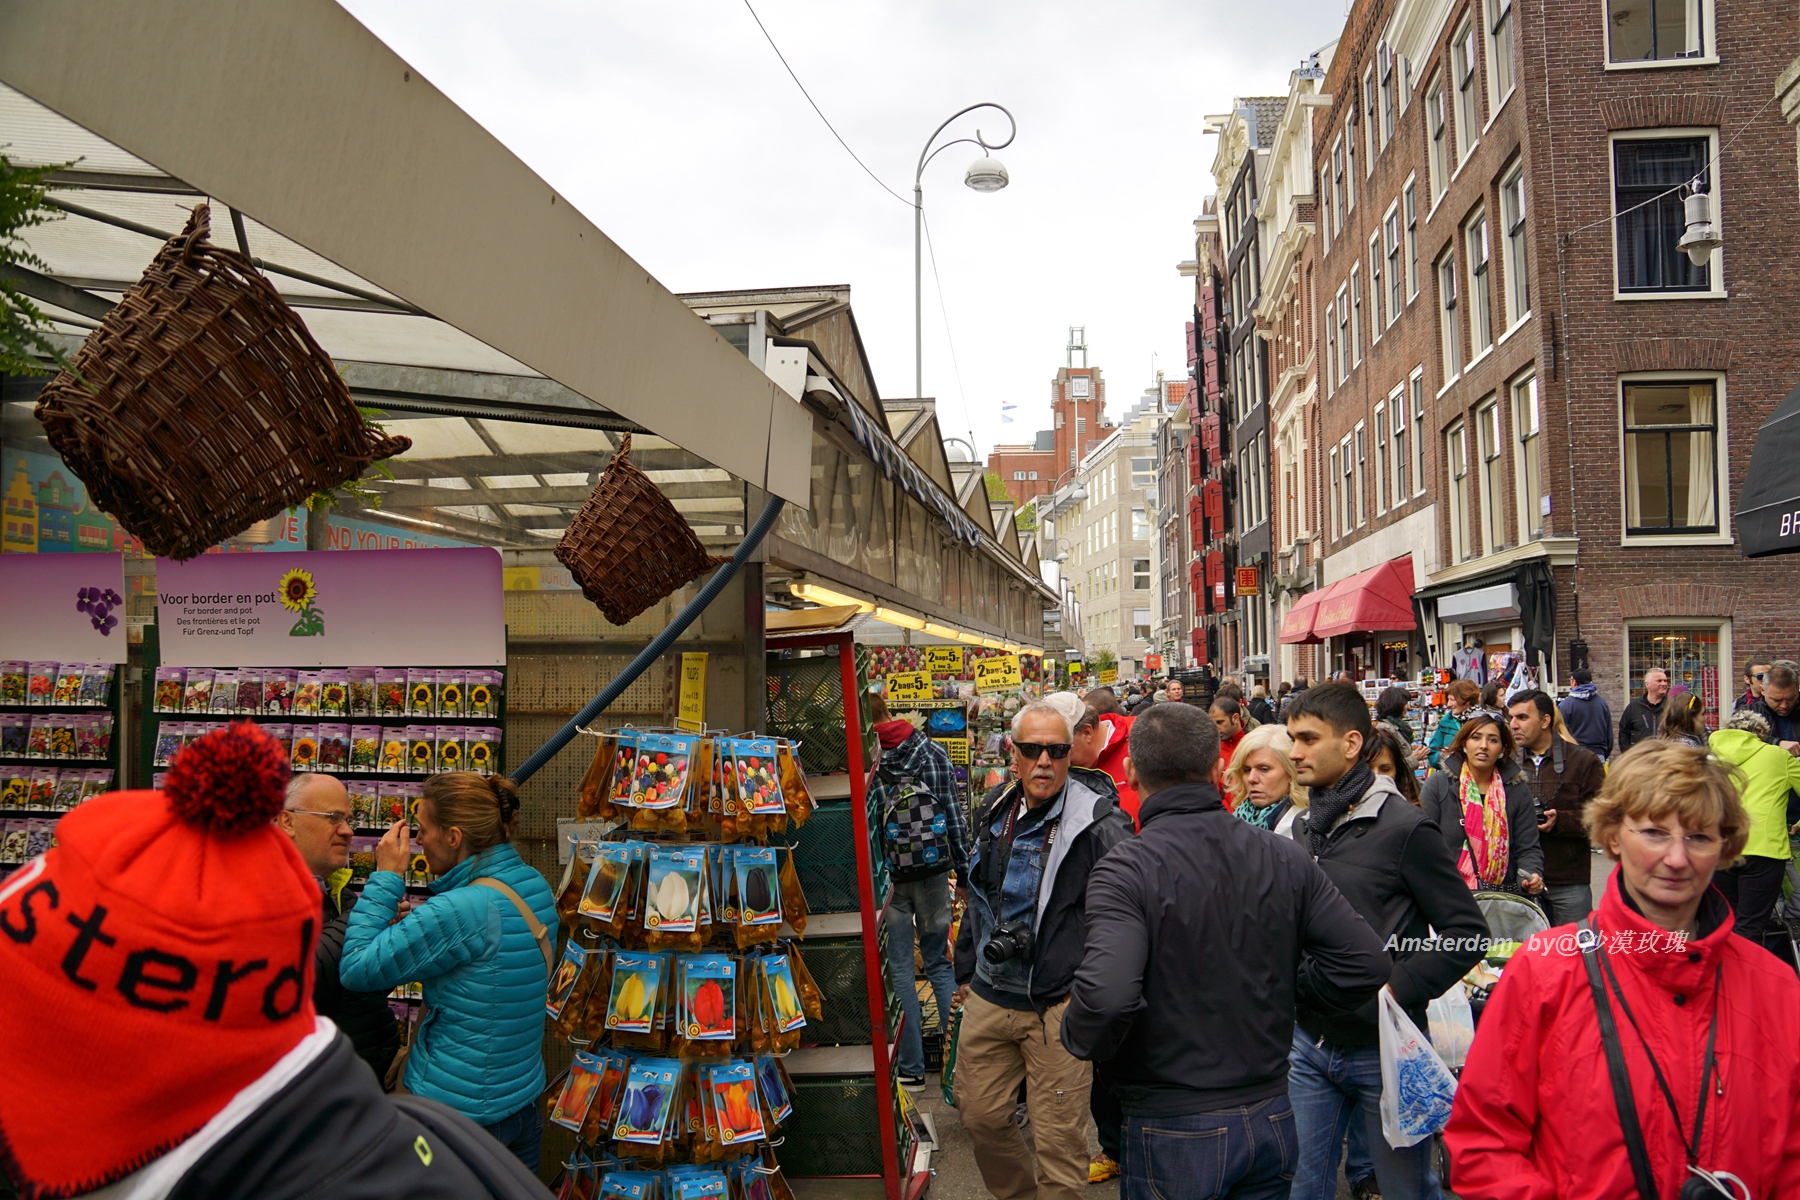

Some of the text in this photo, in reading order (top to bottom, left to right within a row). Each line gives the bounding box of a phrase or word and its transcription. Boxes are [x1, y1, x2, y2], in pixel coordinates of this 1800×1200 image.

[160, 592, 276, 606] Voor border en pot
[240, 607, 252, 616] pot
[248, 618, 260, 626] pot
[237, 628, 254, 636] Topf
[928, 652, 935, 662] 2
[976, 664, 986, 678] 2
[890, 679, 898, 692] 2
